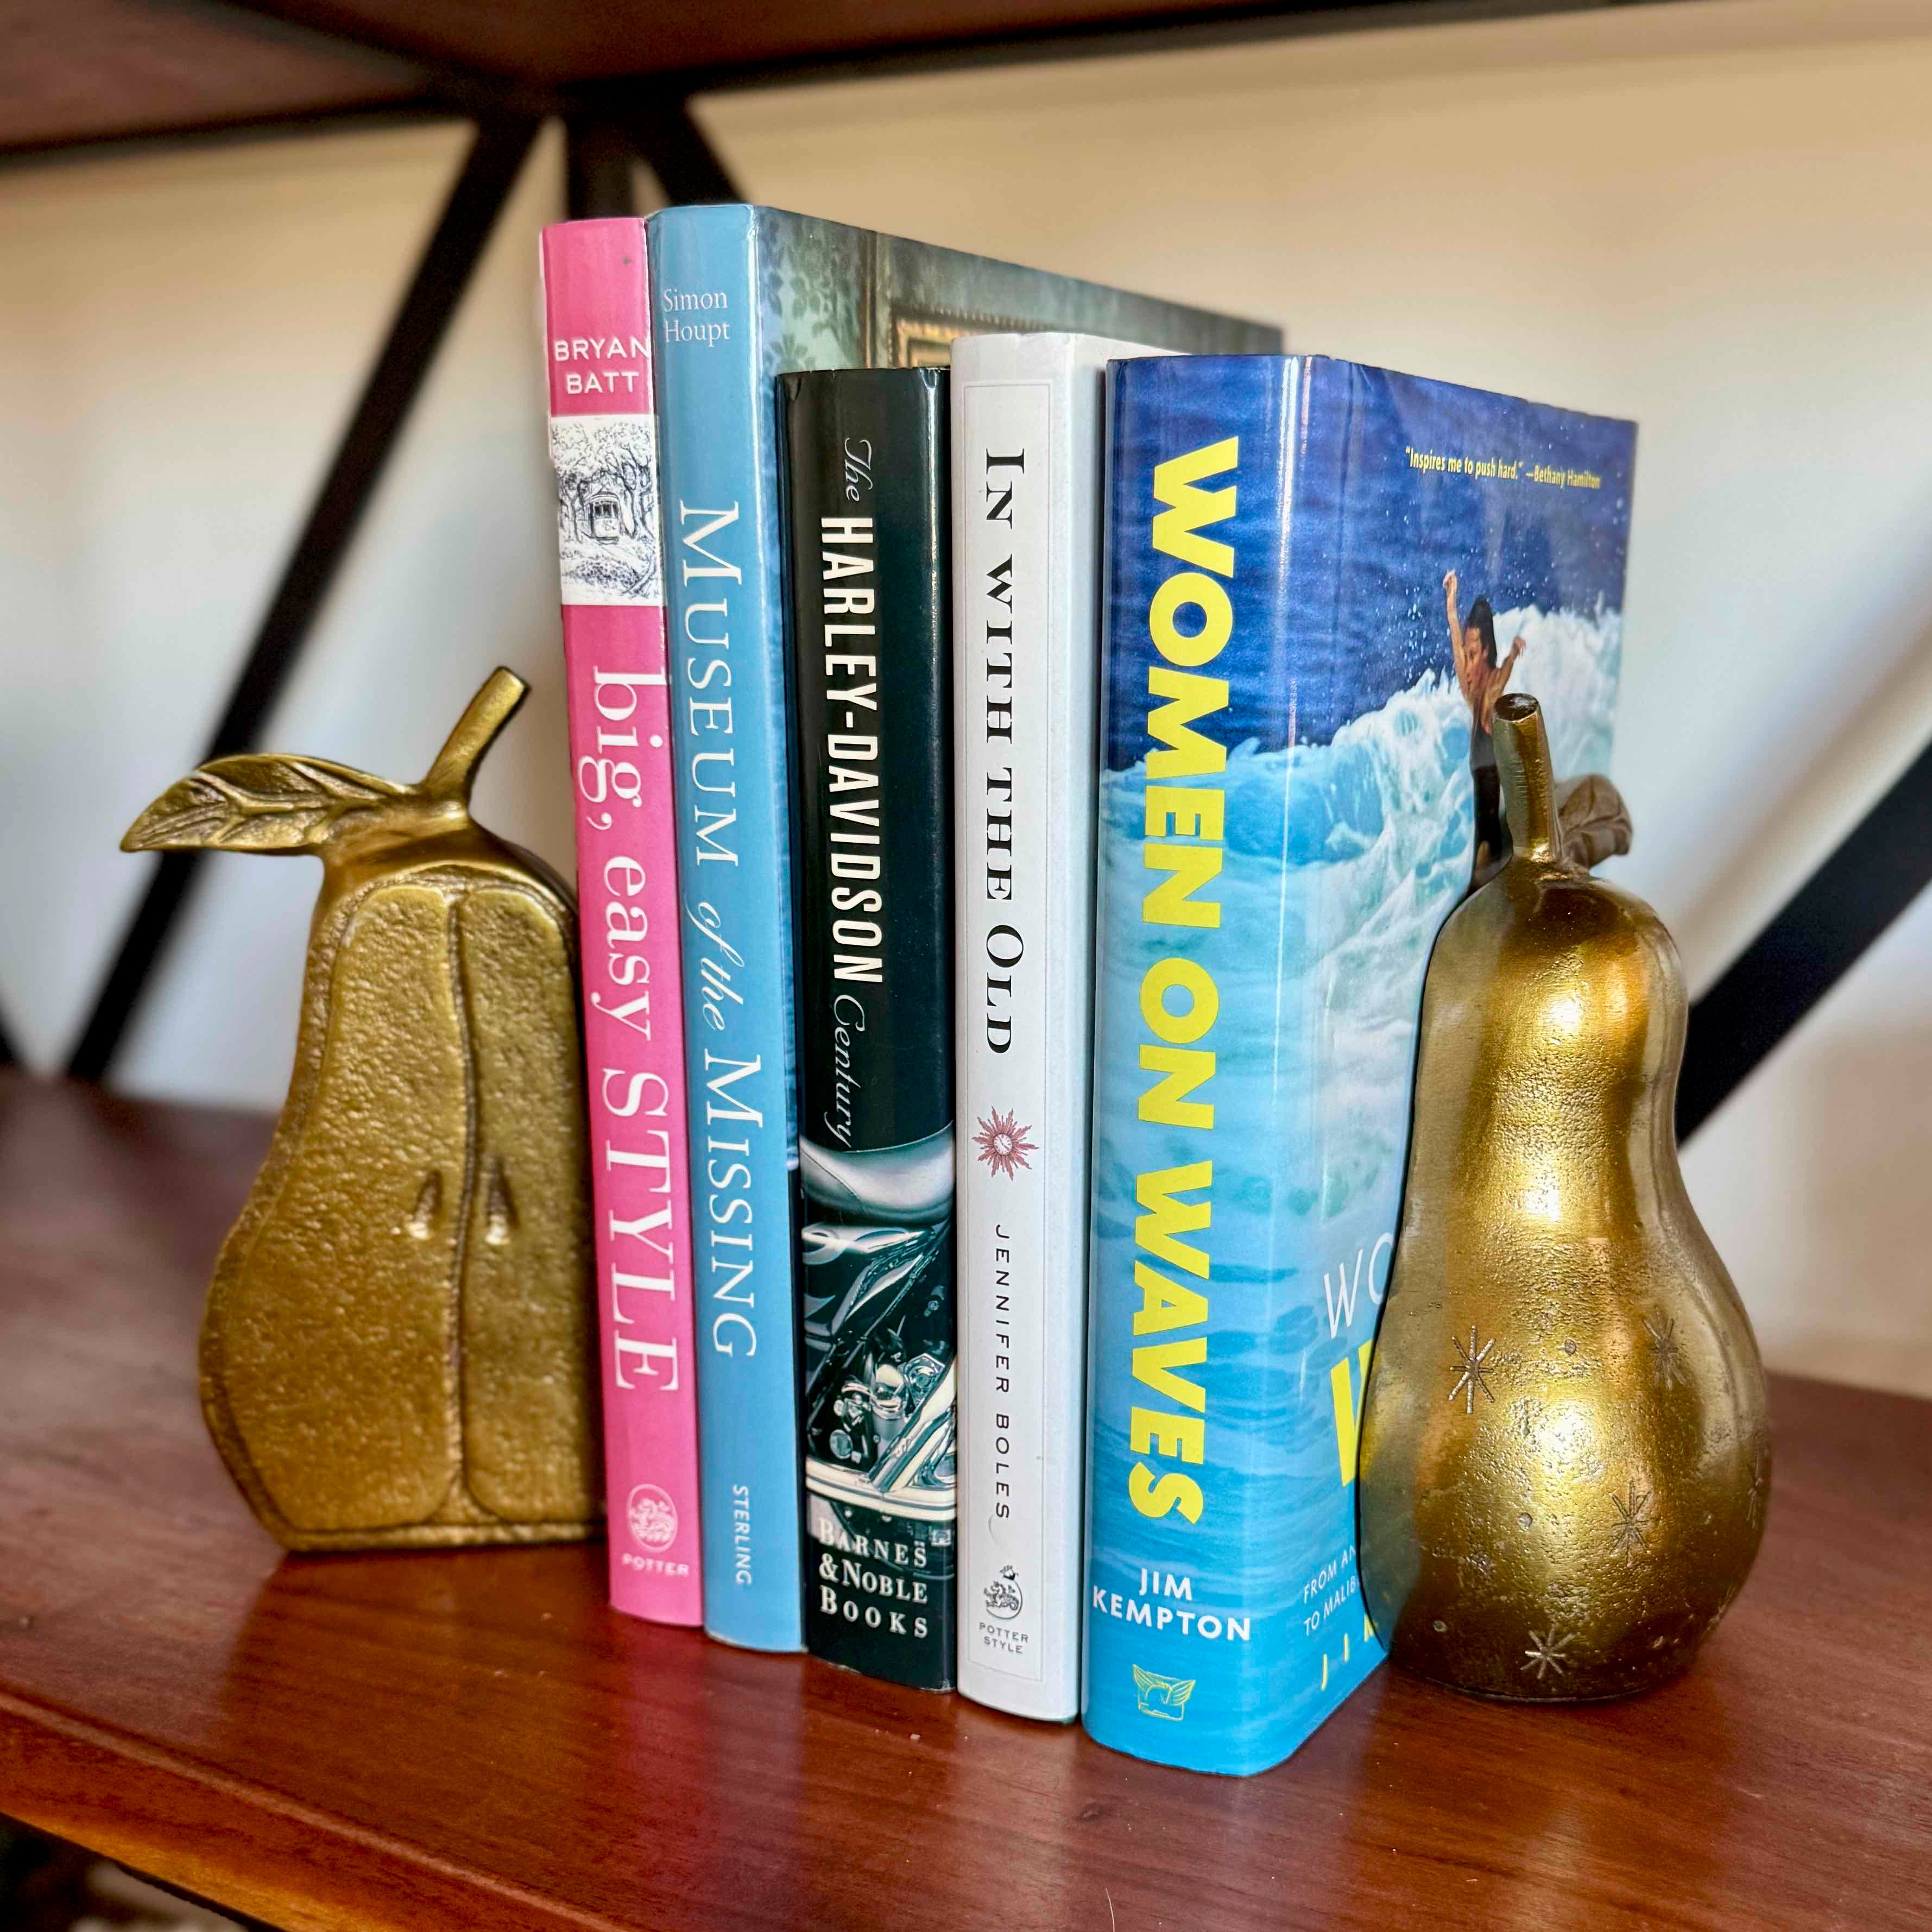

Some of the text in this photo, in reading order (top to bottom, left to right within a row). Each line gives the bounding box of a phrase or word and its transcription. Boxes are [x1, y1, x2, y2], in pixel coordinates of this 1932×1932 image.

[663, 288, 728, 313] Simon
[554, 335, 651, 362] BRYAN
[663, 319, 730, 348] Houpt
[567, 371, 639, 395] BATT
[1448, 457, 1462, 473] me
[1464, 456, 1473, 473] to
[1475, 459, 1495, 479] push
[1567, 469, 1601, 489] Hamilton
[986, 448, 1025, 1054] IN WITH THE OLD
[820, 437, 883, 1148] The HARLEY-DAVIDSON Century
[679, 499, 763, 1358] MUSEUM of the MISSING
[1128, 435, 1239, 1525] WOMEN ON WAVES
[578, 666, 679, 1391] big, easy STYLE
[995, 1224, 1011, 1519] JENNIFER BOLES
[732, 1483, 753, 1587] STERLING
[819, 1517, 927, 1568] BARNES
[622, 1552, 690, 1576] POTTER
[1138, 1568, 1194, 1601] JIM
[1304, 1560, 1337, 1603] FROM
[819, 1584, 928, 1639] BOOKS
[978, 1621, 1029, 1644] POTTER
[1092, 1584, 1251, 1641] KEMPTON
[1304, 1611, 1319, 1637] TO
[983, 1636, 1024, 1655] STYLE
